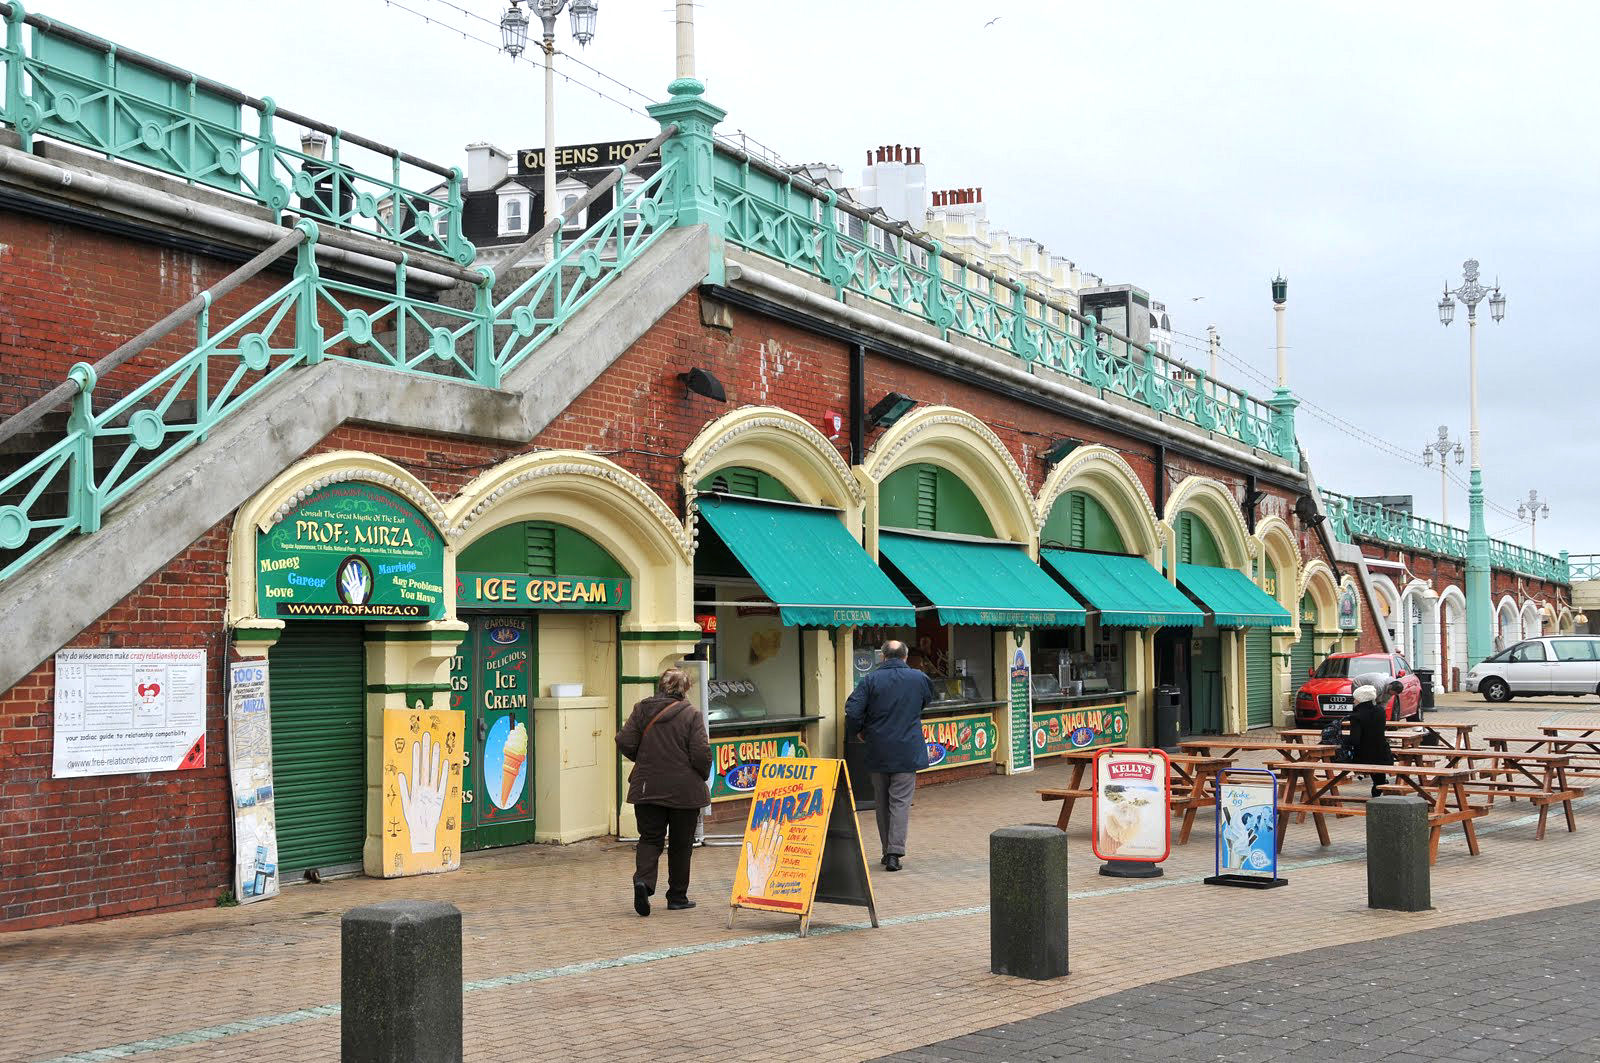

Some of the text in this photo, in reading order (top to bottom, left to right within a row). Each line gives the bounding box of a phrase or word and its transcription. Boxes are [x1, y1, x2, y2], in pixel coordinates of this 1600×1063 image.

[300, 508, 406, 524] Consult The Great Mystic Of The East
[295, 519, 415, 548] PROF: MIRZA
[260, 556, 300, 573] Money
[378, 561, 417, 574] Marriage
[288, 572, 327, 588] Career
[392, 575, 443, 593] Any Problems
[265, 584, 294, 598] Love
[400, 588, 436, 604] You Have
[475, 577, 607, 603] ICE CREAM
[287, 603, 419, 615] WWW.PROFMIRZA.CO
[484, 618, 526, 631] CAROUSELS
[57, 652, 69, 662] why
[70, 652, 77, 660] do
[78, 652, 92, 660] wise
[114, 652, 129, 660] make
[130, 653, 145, 662] crazy
[145, 652, 178, 662] relationship
[486, 650, 527, 670] DELICIOUS
[449, 675, 469, 691] GS
[243, 698, 266, 713] MIRZA
[1061, 710, 1103, 738] SNACK BAR
[99, 733, 115, 741] guide
[125, 731, 153, 739] relationship
[155, 730, 187, 738] compatibility
[937, 721, 960, 748] BAR
[716, 740, 778, 775] ICE CREAM
[761, 763, 818, 780] CONSULT
[1111, 764, 1152, 775] KELLY'S
[757, 783, 804, 799] PROFESSOR
[1227, 790, 1249, 799] Flake
[751, 788, 824, 832] MIRZA
[1232, 799, 1243, 807] 99
